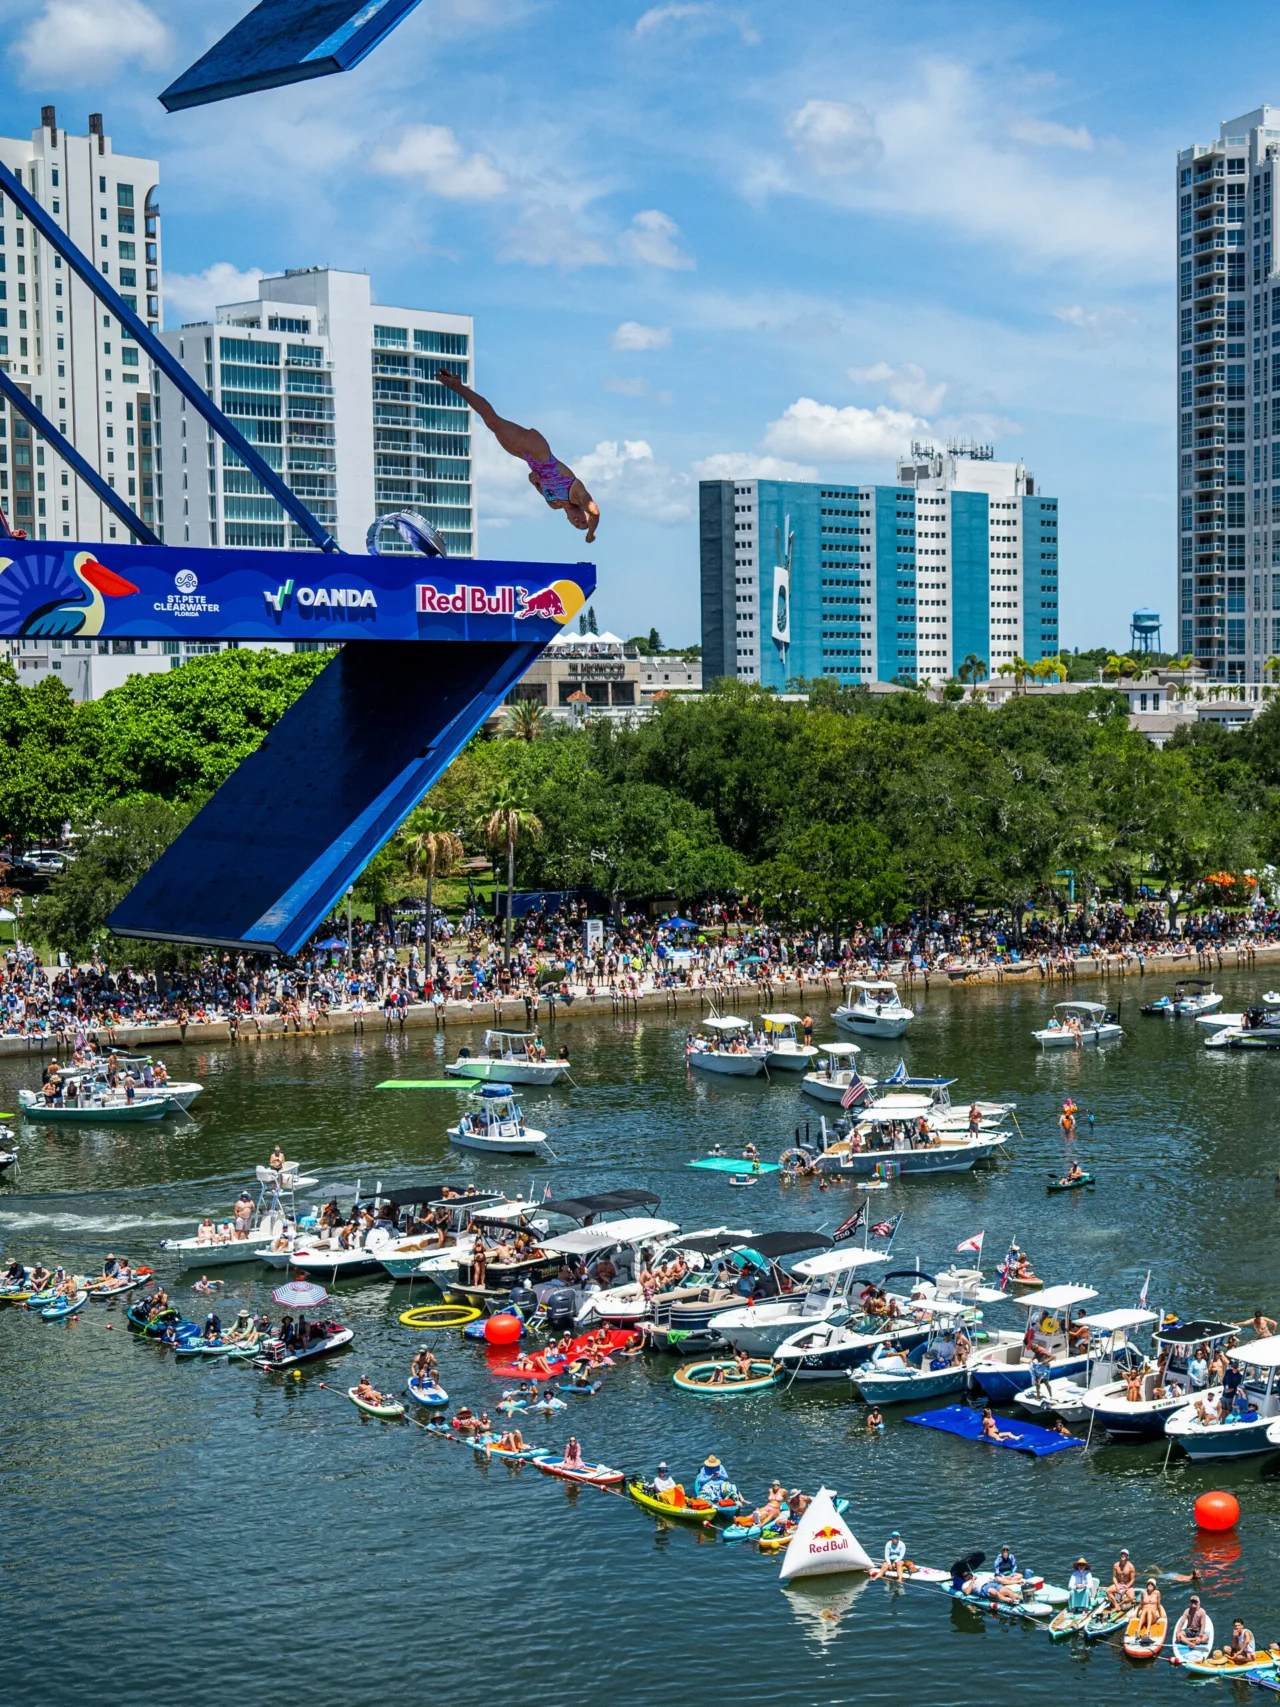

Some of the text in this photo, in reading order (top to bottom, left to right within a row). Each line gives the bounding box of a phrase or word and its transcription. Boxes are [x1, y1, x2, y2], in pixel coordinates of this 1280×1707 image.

[297, 587, 377, 608] OANDA
[420, 586, 513, 613] Red Bull
[153, 602, 220, 612] CLEARWATER
[809, 1539, 849, 1553] Red Bull
